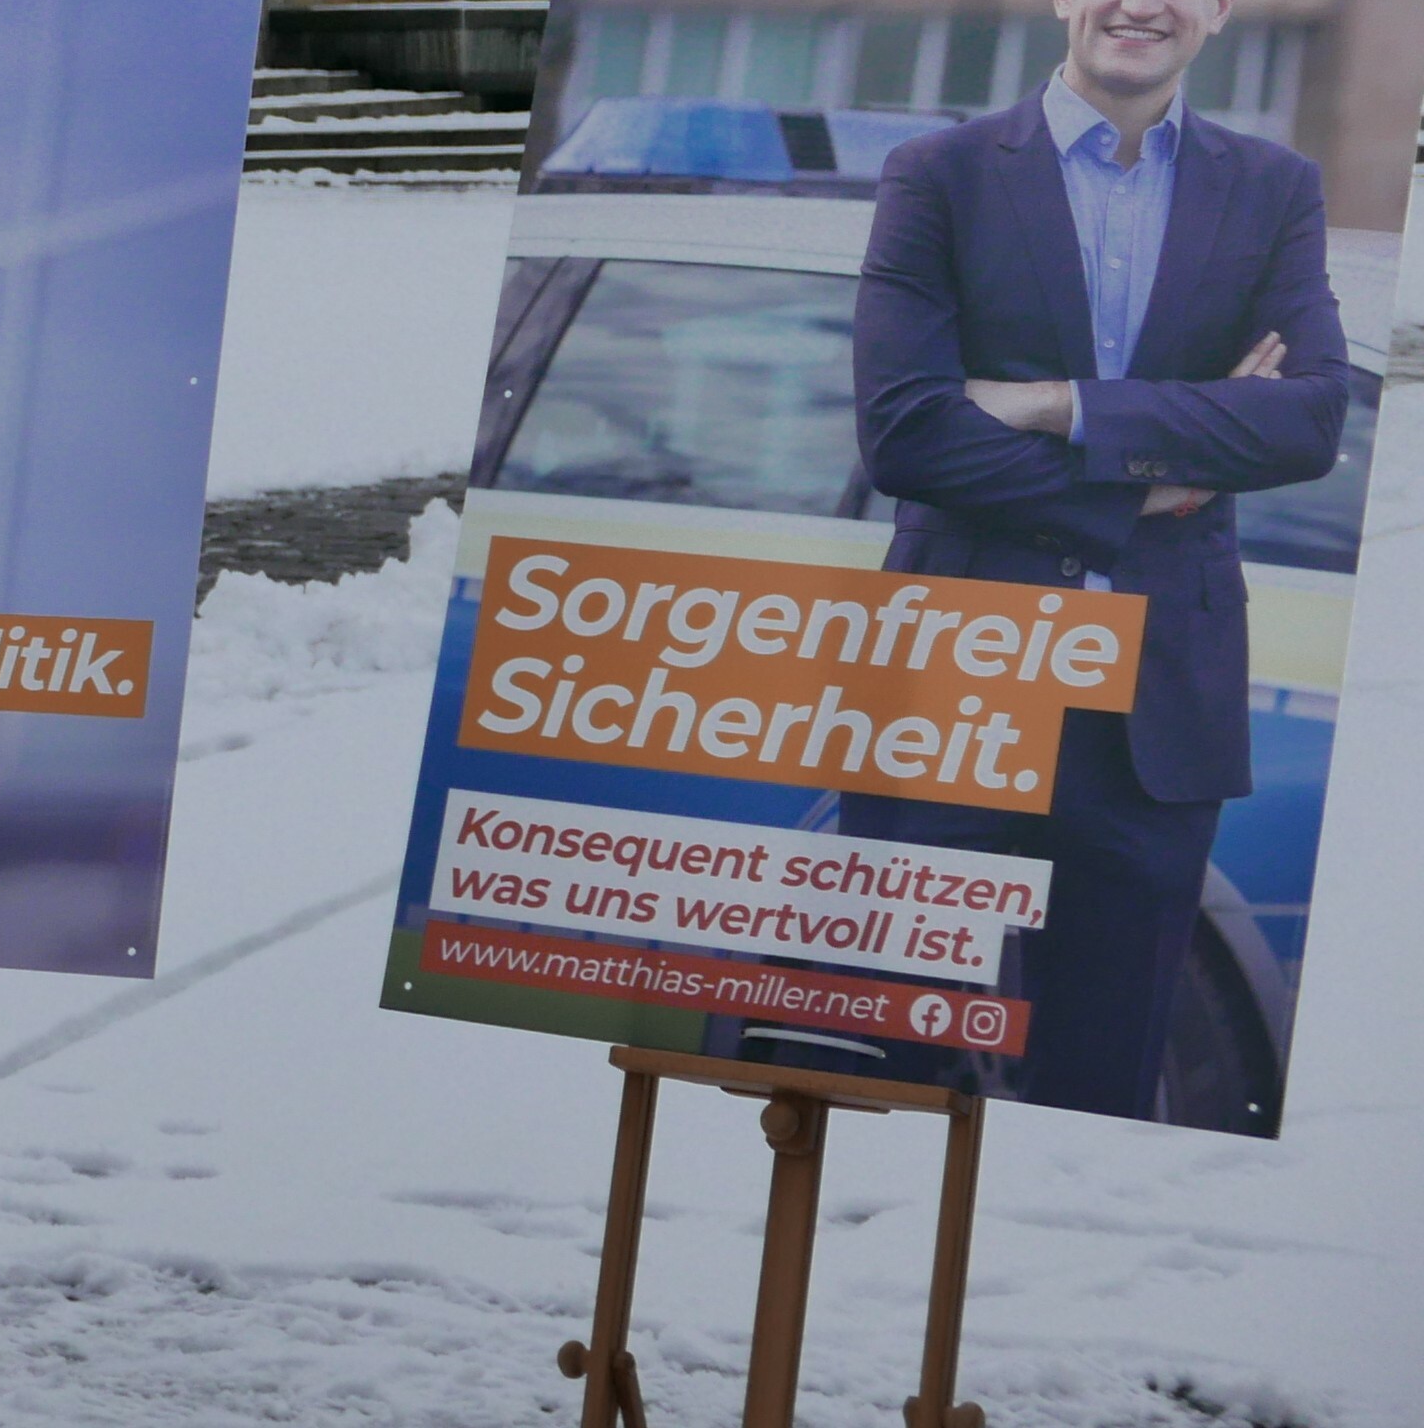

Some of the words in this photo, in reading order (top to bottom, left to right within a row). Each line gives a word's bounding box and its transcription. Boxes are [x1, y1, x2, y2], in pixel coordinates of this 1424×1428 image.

[495, 554, 1119, 689] Sorgenfreie
[477, 654, 1041, 795] Sicherheit.
[449, 867, 551, 909] was
[564, 883, 658, 924] uns
[675, 895, 893, 956] wertvoll
[904, 913, 984, 968] ist.
[457, 807, 768, 883] Konsequent
[780, 851, 1044, 926] schützen,
[439, 938, 890, 1024] www.matthias-miller.net
